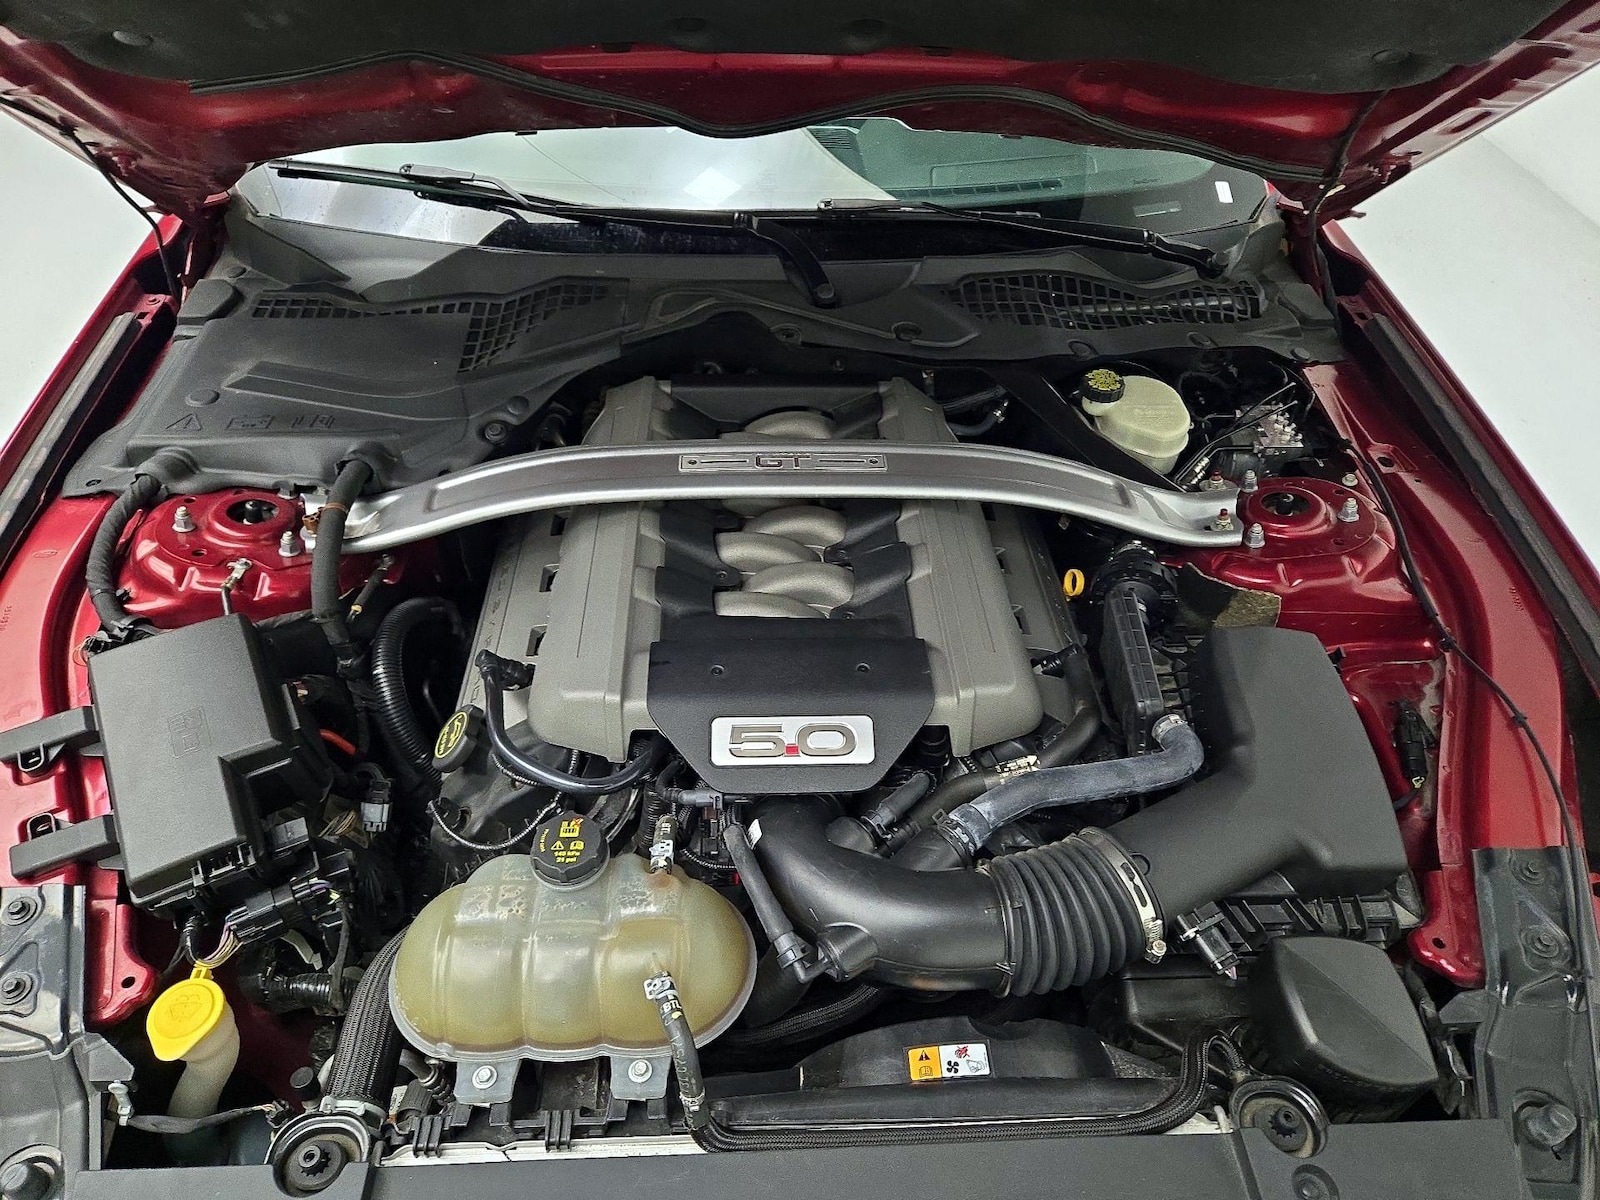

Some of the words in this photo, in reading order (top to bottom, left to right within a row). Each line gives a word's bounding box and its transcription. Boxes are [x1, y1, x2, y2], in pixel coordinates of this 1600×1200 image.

[755, 453, 811, 469] GT
[728, 723, 857, 758] 5.0
[662, 999, 682, 1013] BTL
